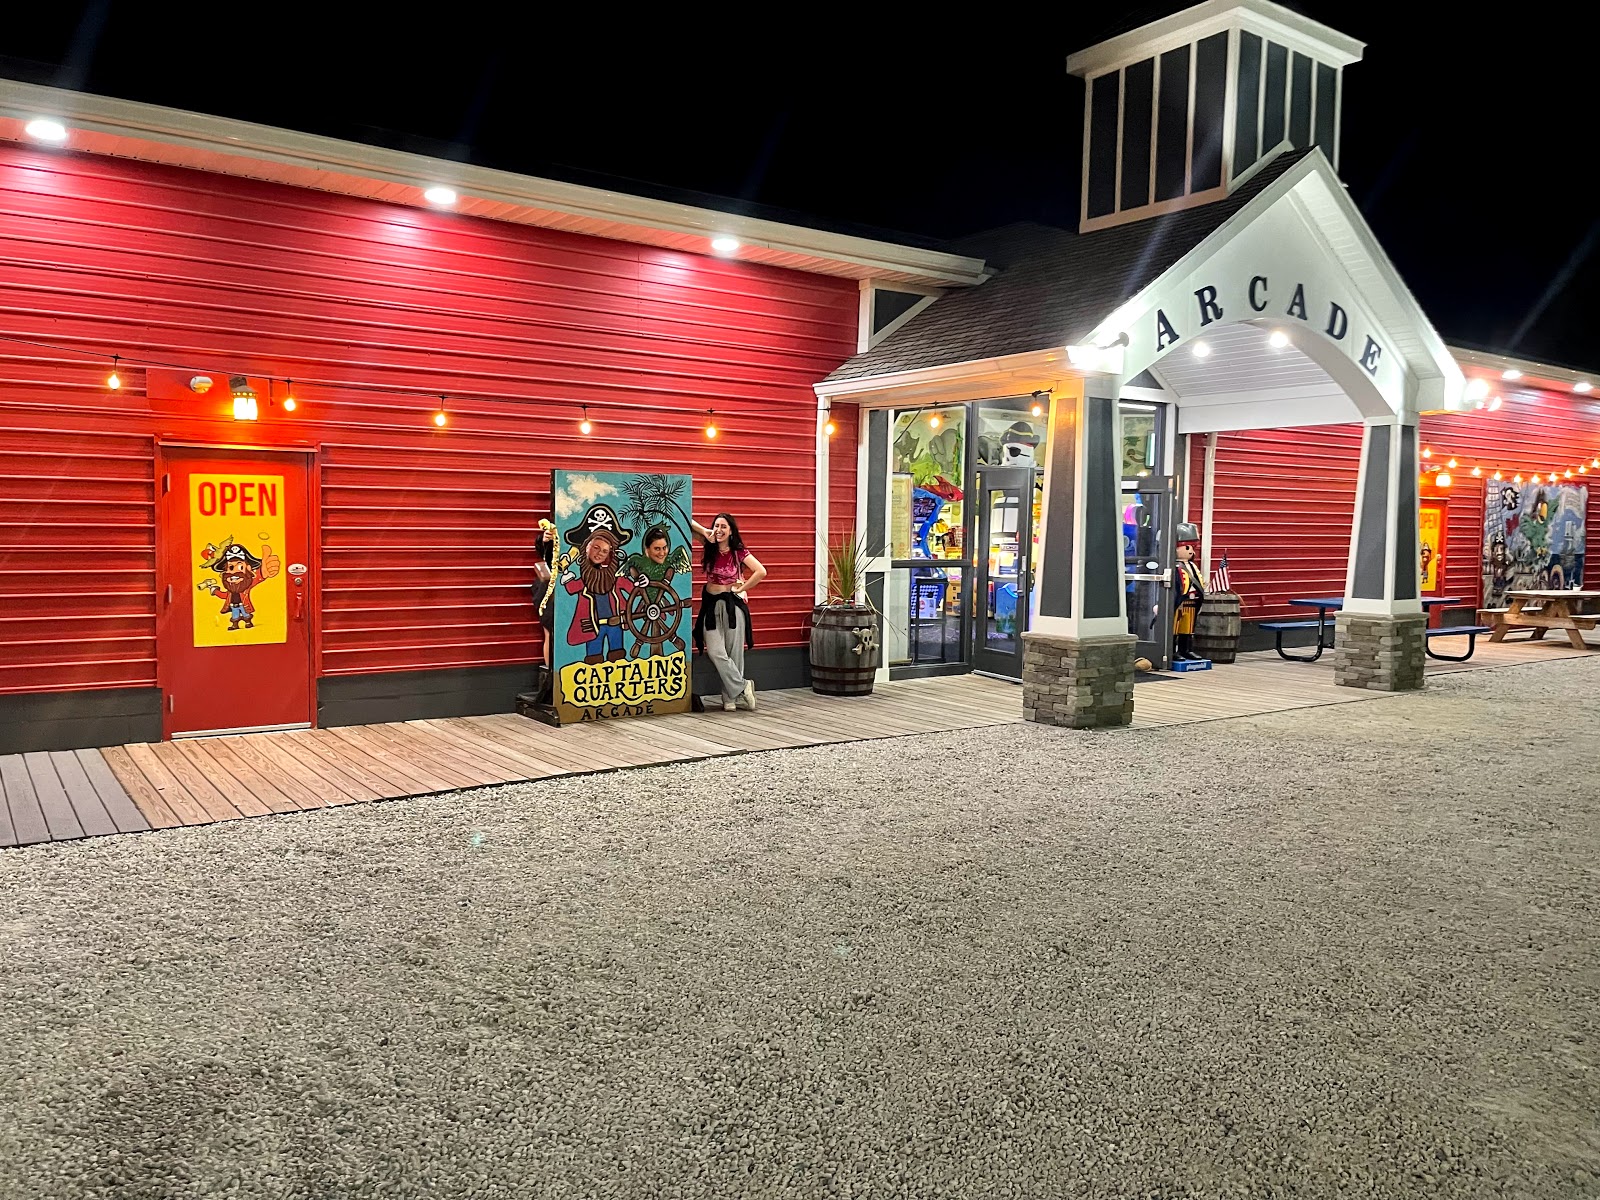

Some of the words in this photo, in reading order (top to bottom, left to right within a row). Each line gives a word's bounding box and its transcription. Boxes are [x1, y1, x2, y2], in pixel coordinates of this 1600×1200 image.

[1156, 275, 1382, 376] ARCADE
[198, 481, 277, 516] OPEN
[573, 656, 684, 685] CAPTAIN'S
[573, 677, 683, 702] QUARTERS
[580, 705, 654, 721] ARCADE
